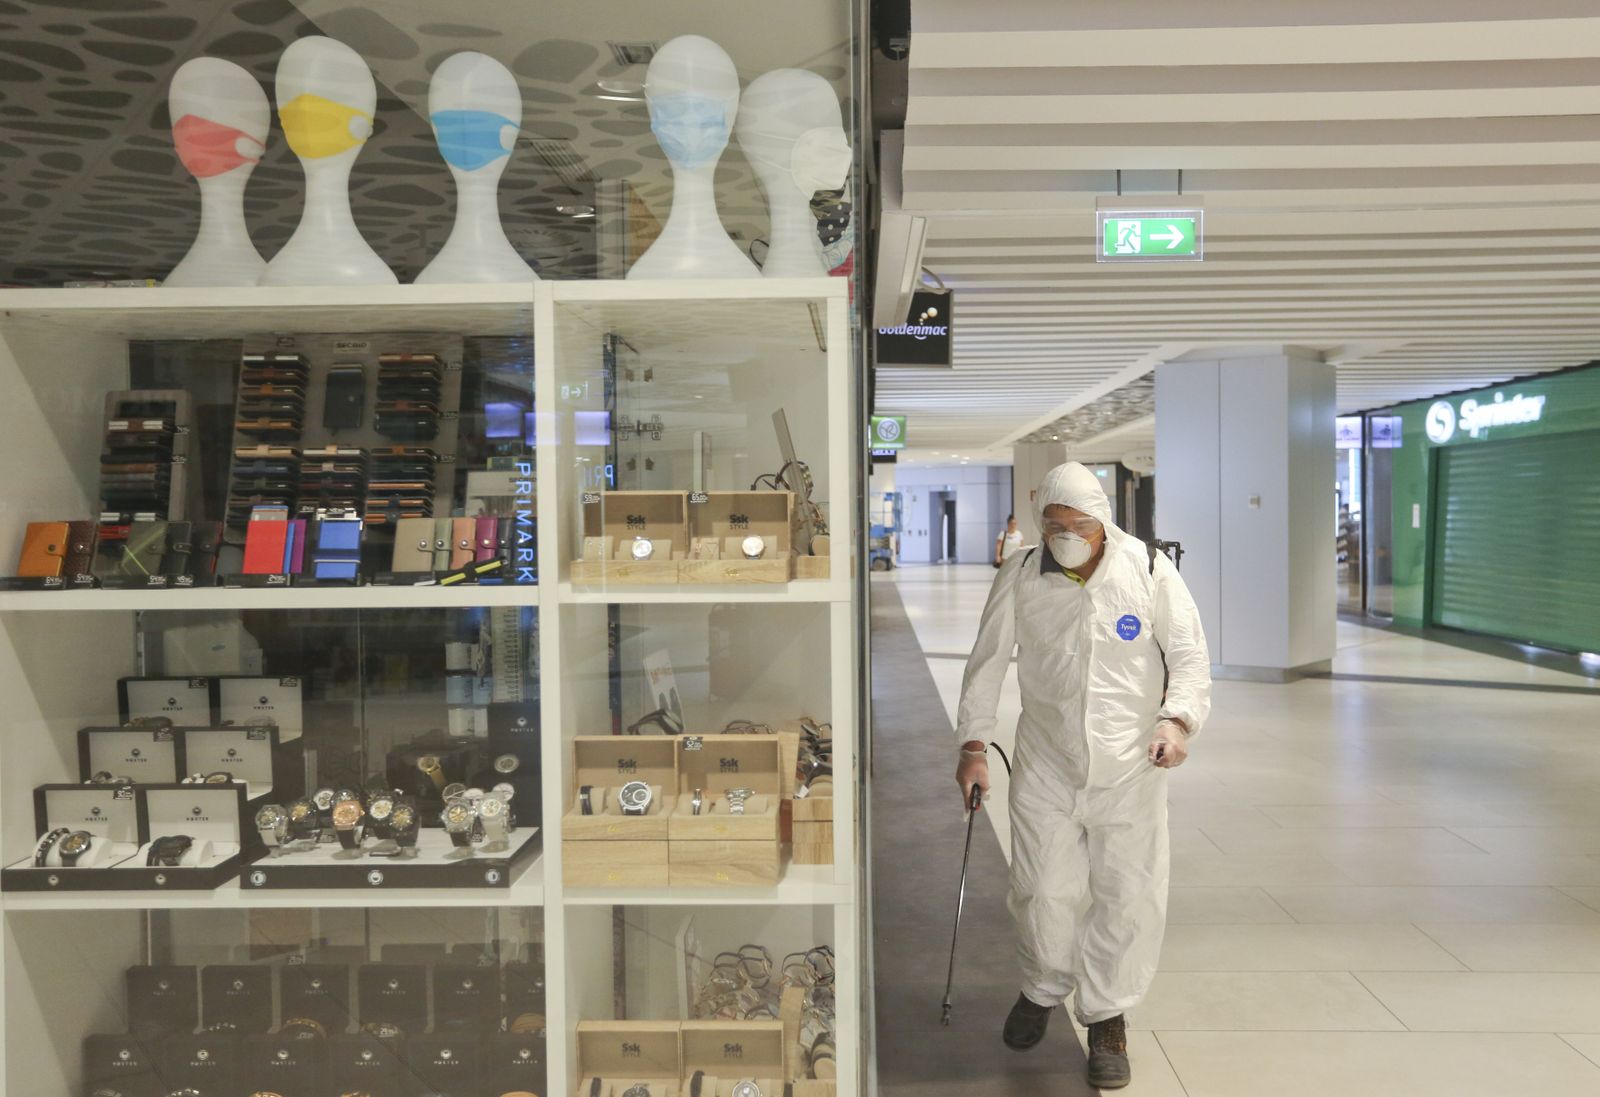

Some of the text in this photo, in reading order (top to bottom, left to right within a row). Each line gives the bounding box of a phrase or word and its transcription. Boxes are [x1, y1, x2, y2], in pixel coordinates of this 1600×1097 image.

[1458, 391, 1547, 439] Sprinter
[514, 462, 535, 583] PRIMARK
[626, 514, 646, 524] Ssk
[729, 514, 749, 524] Ssk
[618, 758, 637, 768] Ssk
[720, 758, 739, 768] Ssk
